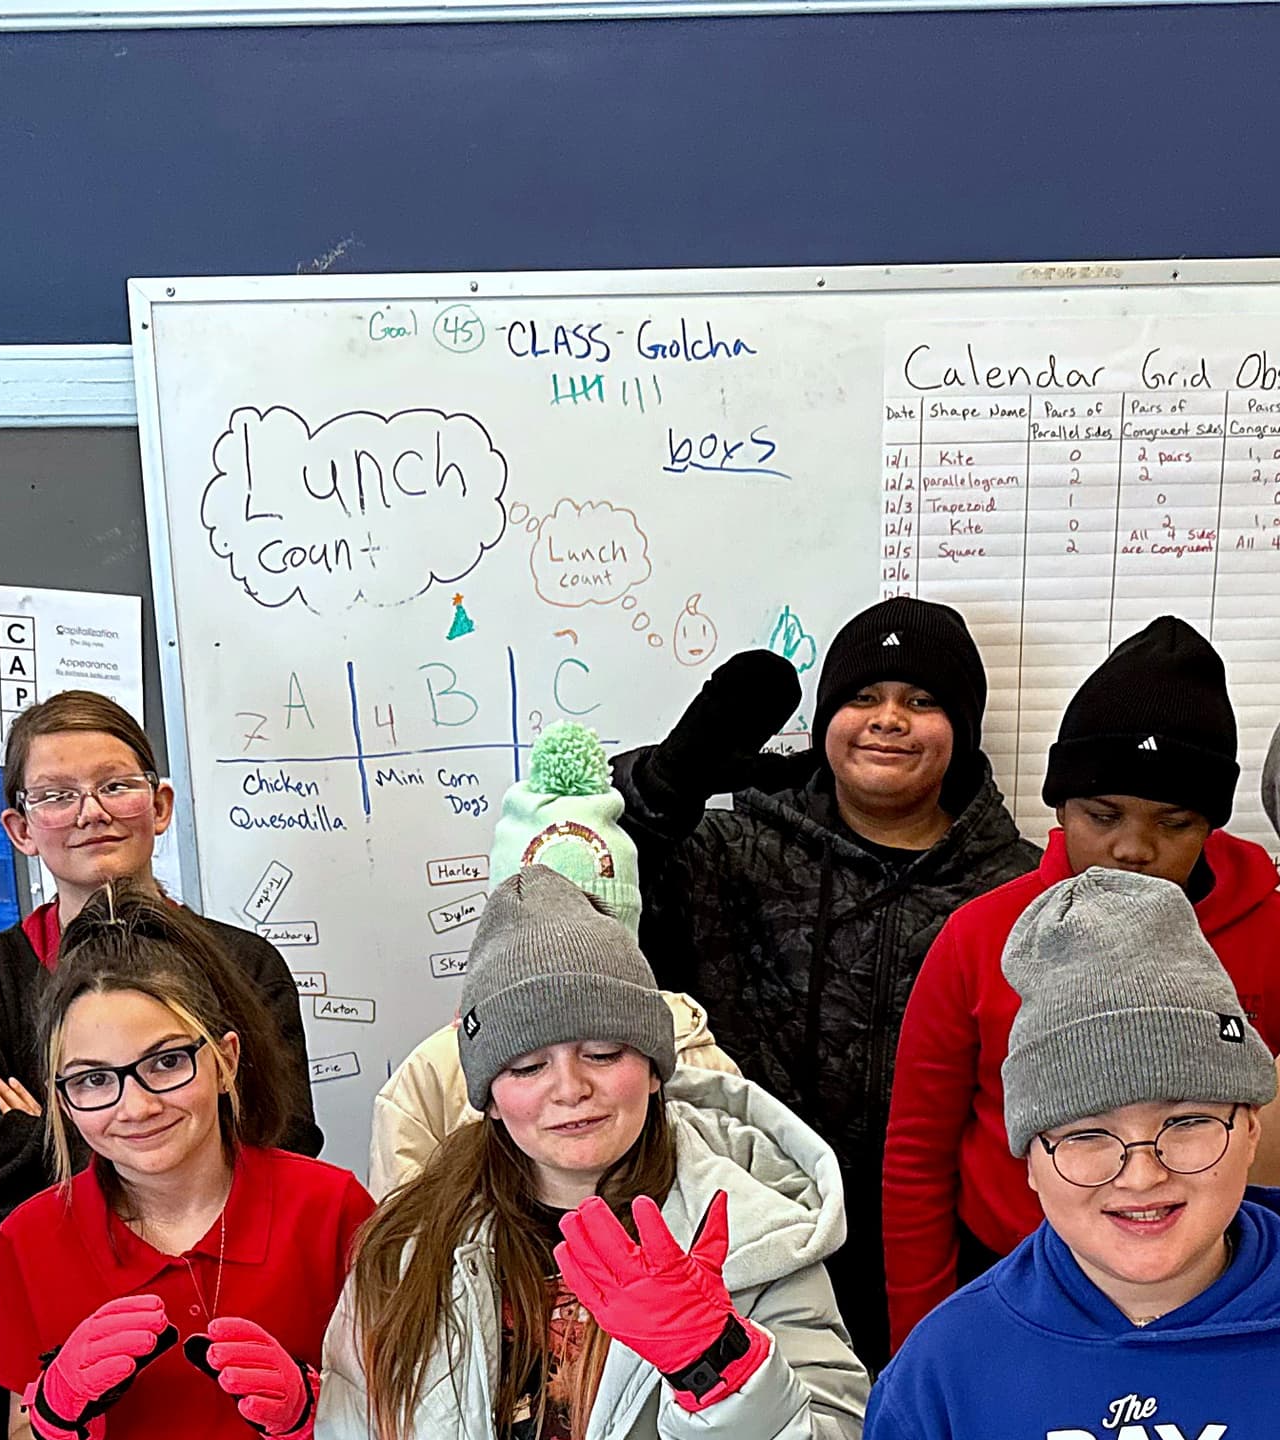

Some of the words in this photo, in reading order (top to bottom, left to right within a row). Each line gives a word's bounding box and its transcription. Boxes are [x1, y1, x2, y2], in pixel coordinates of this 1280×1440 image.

[368, 308, 418, 342] Goal
[439, 316, 477, 346] 45
[904, 342, 1106, 391] Calendar
[1141, 347, 1212, 391] Grid
[886, 404, 917, 421] Date
[929, 402, 981, 421] Shape
[989, 403, 1028, 420] Name
[1043, 400, 1077, 419] Pairs
[1086, 401, 1104, 416] of
[1130, 399, 1163, 415] Pairs
[1170, 399, 1187, 413] of
[1031, 422, 1080, 440] Parallel
[1122, 422, 1190, 441] Congruent
[886, 448, 909, 468] 12/1
[939, 449, 977, 467] Kite
[1136, 446, 1148, 462] 2
[1158, 450, 1193, 466] pairs
[244, 422, 468, 523] Lunch
[885, 472, 916, 492] 12/2
[922, 471, 1020, 493] parallelogram
[1070, 467, 1083, 485] 2
[885, 494, 913, 515] 12/3
[925, 496, 998, 515] Trapezoid
[885, 517, 913, 538] 12/4
[949, 518, 984, 535] Kite
[1130, 529, 1149, 541] All
[548, 535, 629, 566] Lunch
[884, 537, 912, 558] 12/5
[938, 542, 987, 563] Square
[1236, 535, 1255, 551] All
[883, 560, 911, 582] 12/6
[7, 623, 26, 644] C
[55, 624, 119, 640] Capitalization
[9, 655, 26, 676] A
[59, 656, 119, 672] Appearance
[417, 662, 480, 727] B
[552, 657, 603, 716] C
[16, 687, 28, 708] P
[283, 671, 316, 731] A
[373, 702, 398, 748] 4
[242, 767, 321, 798] Chicken
[374, 768, 425, 788] Mini
[437, 766, 481, 787] Corn
[444, 794, 490, 817] Dogs
[229, 803, 349, 835] Quesadilla
[438, 863, 481, 879] Harley
[440, 904, 477, 924] Dylan
[1101, 1393, 1158, 1430] The
